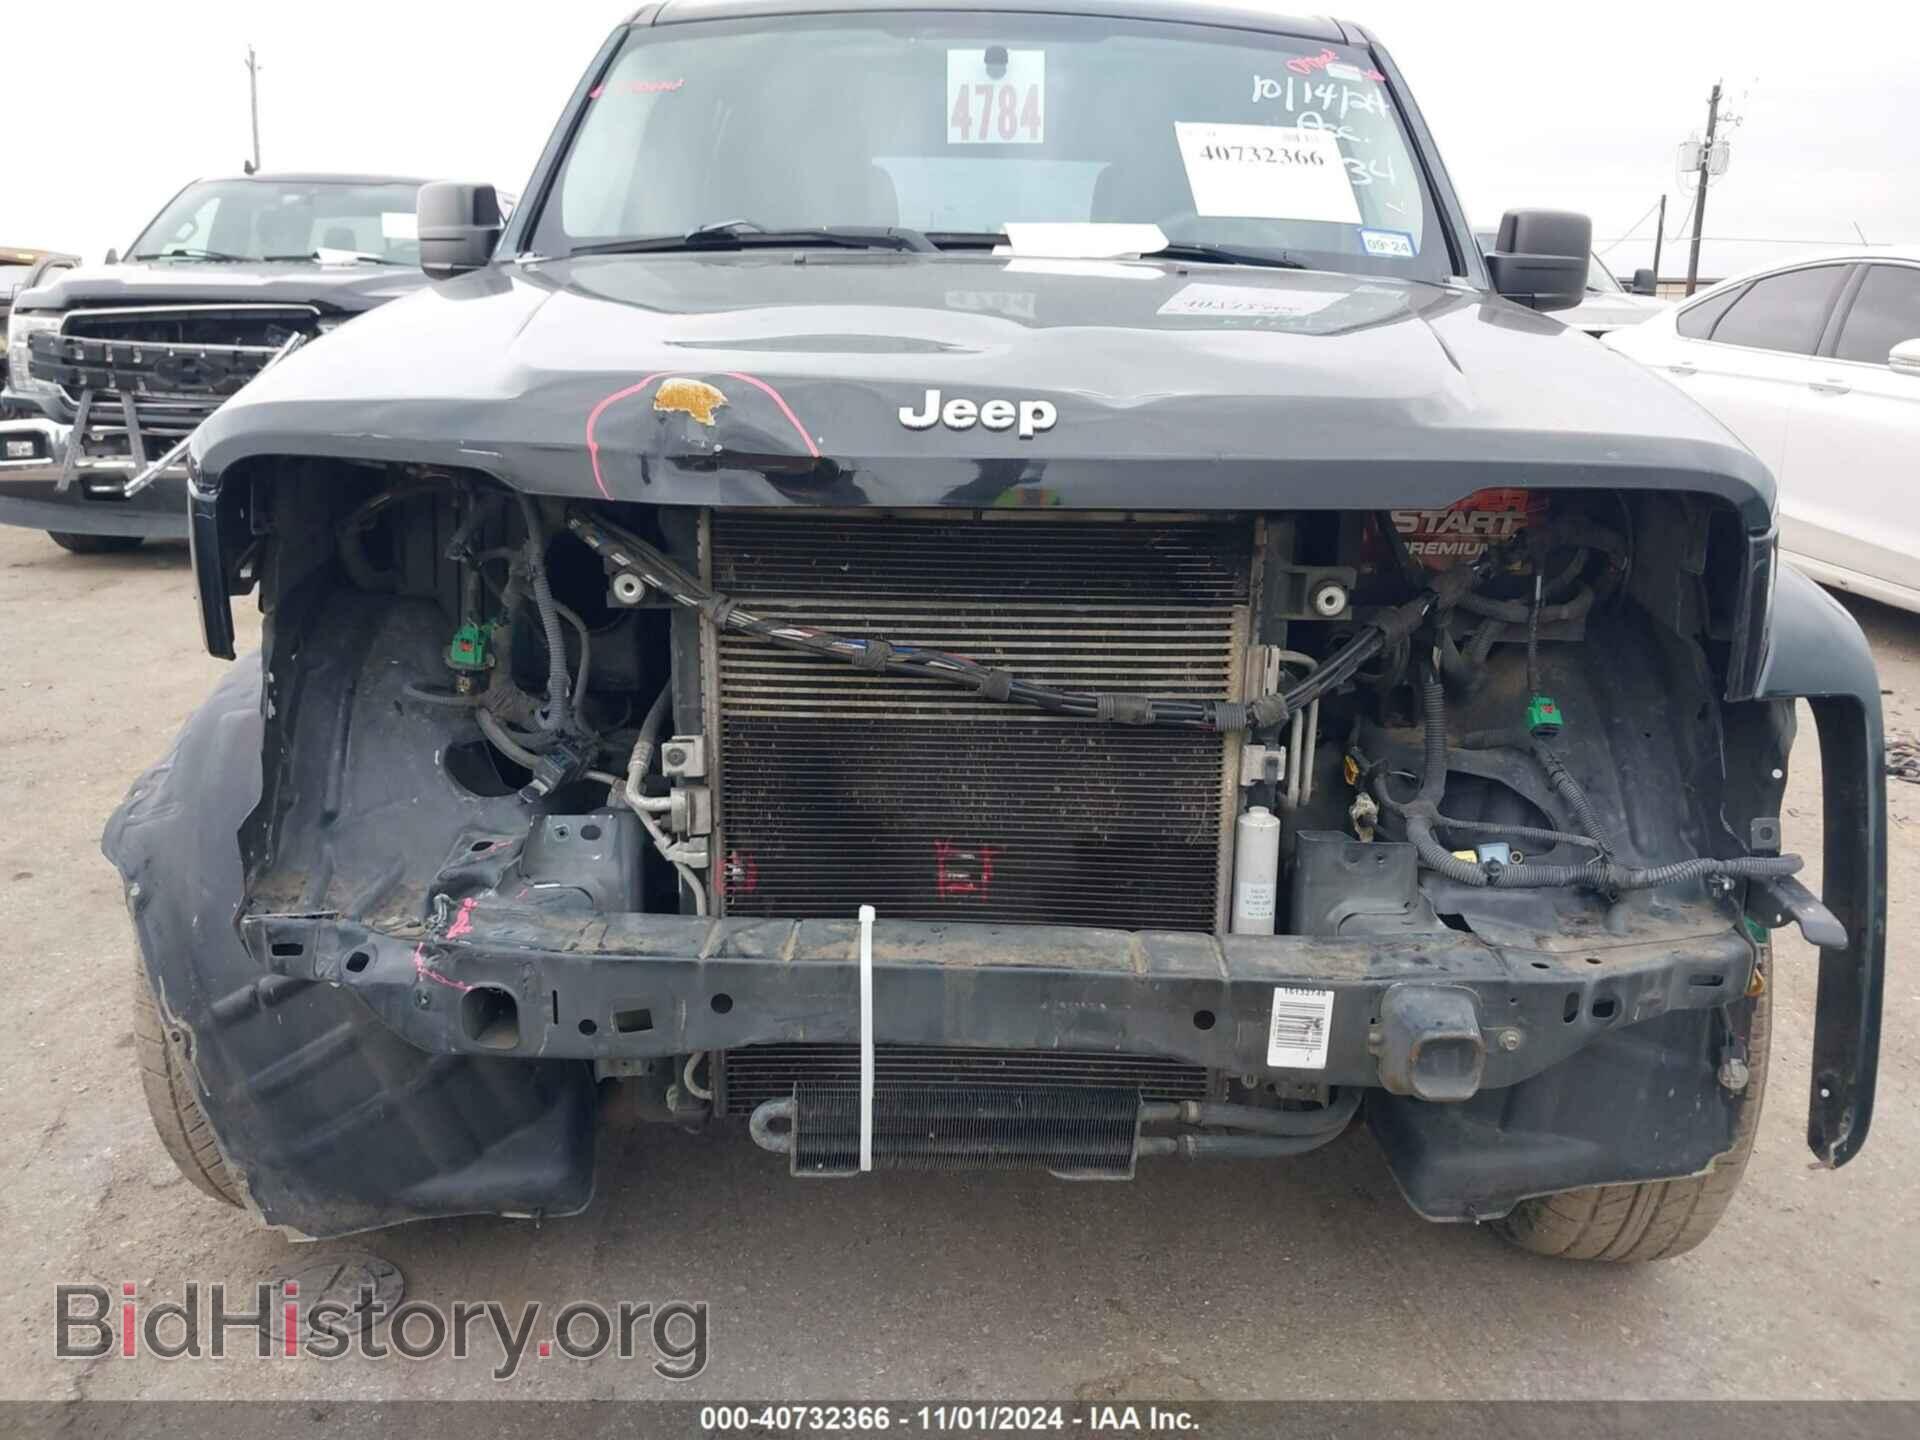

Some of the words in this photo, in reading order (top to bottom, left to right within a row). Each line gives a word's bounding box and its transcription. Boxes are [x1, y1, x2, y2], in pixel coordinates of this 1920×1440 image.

[951, 83, 1041, 140] 4784
[1200, 145, 1325, 167] 40732366
[899, 389, 1057, 440] Jeep
[1391, 511, 1527, 534] START
